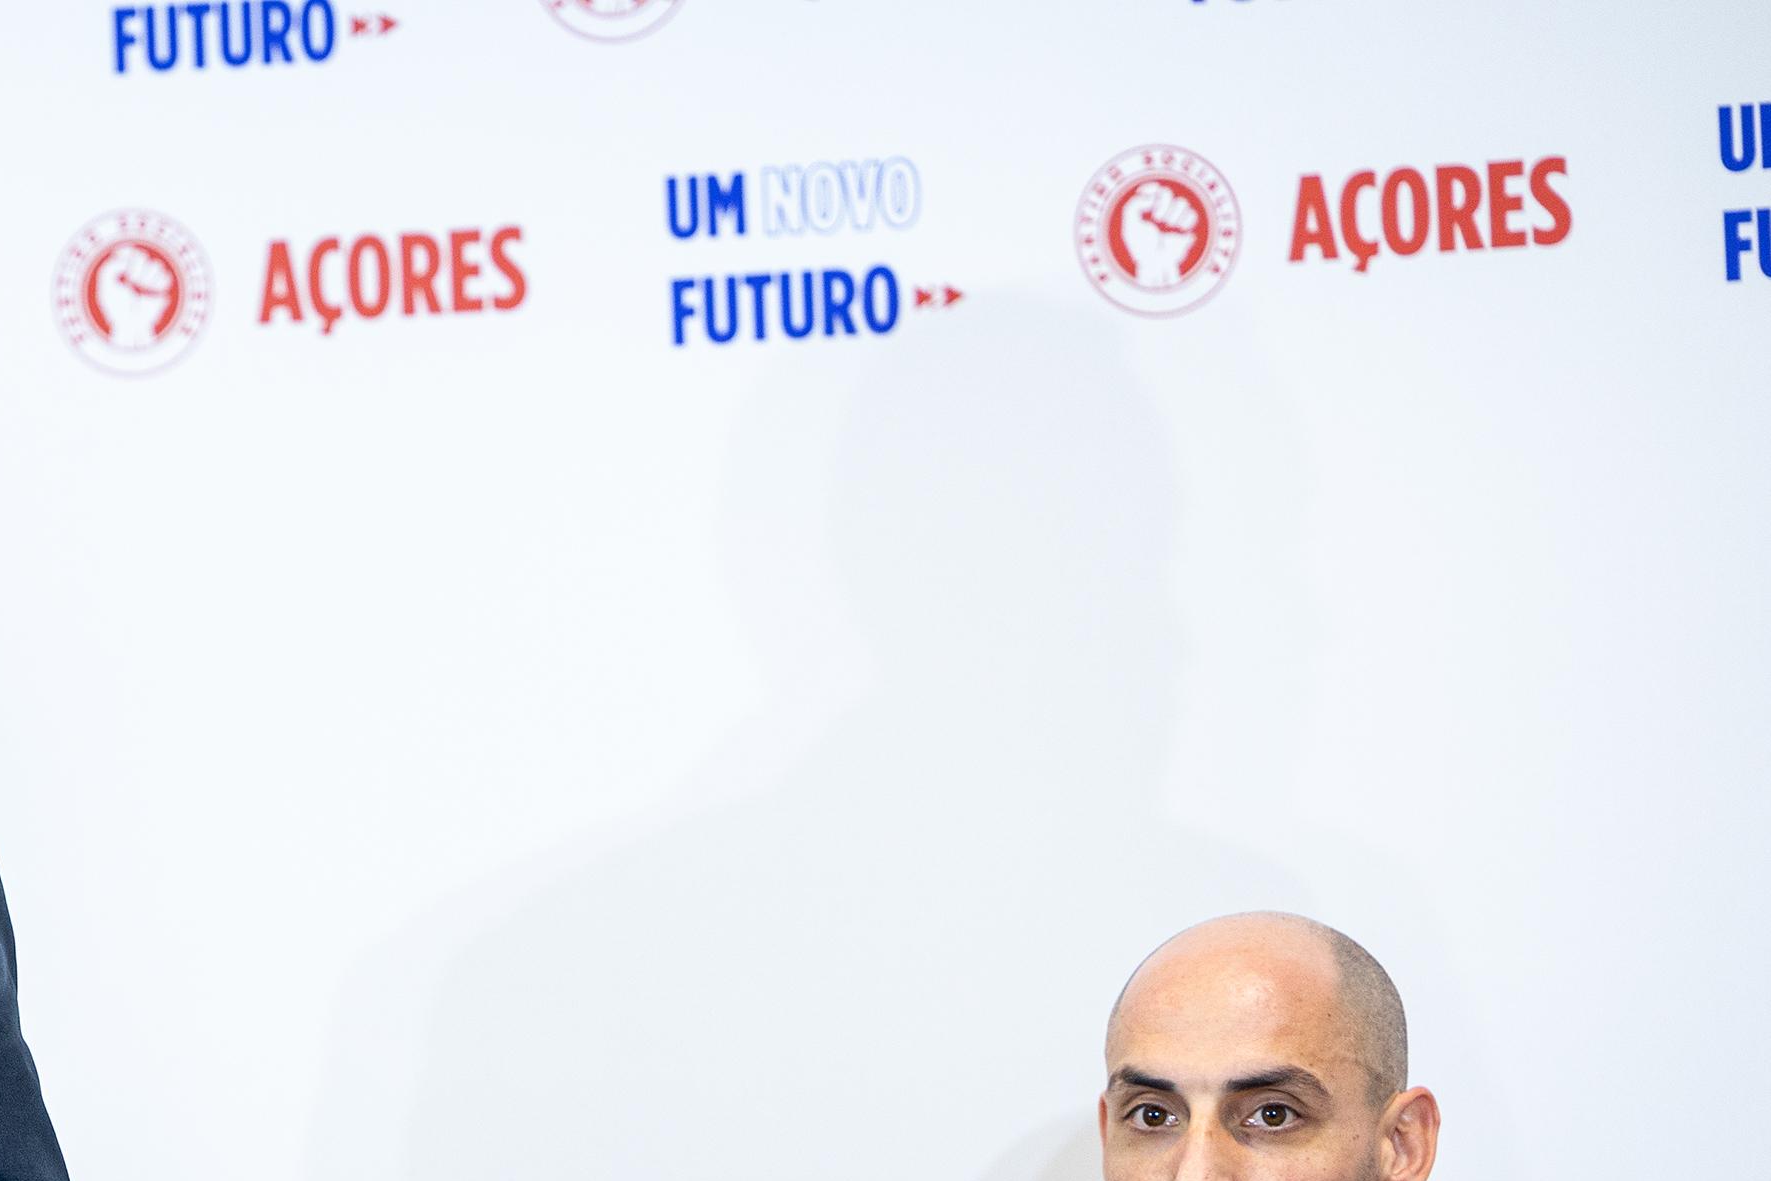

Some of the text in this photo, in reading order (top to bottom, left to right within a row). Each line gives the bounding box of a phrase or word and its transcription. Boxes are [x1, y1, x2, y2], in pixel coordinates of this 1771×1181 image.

[114, 0, 335, 73] FUTURO
[1718, 103, 1771, 172] U
[667, 155, 922, 239] UM NOVO
[1288, 155, 1573, 273] AÇORES
[258, 226, 527, 335] AÇORES
[672, 264, 900, 346] FUTURO
